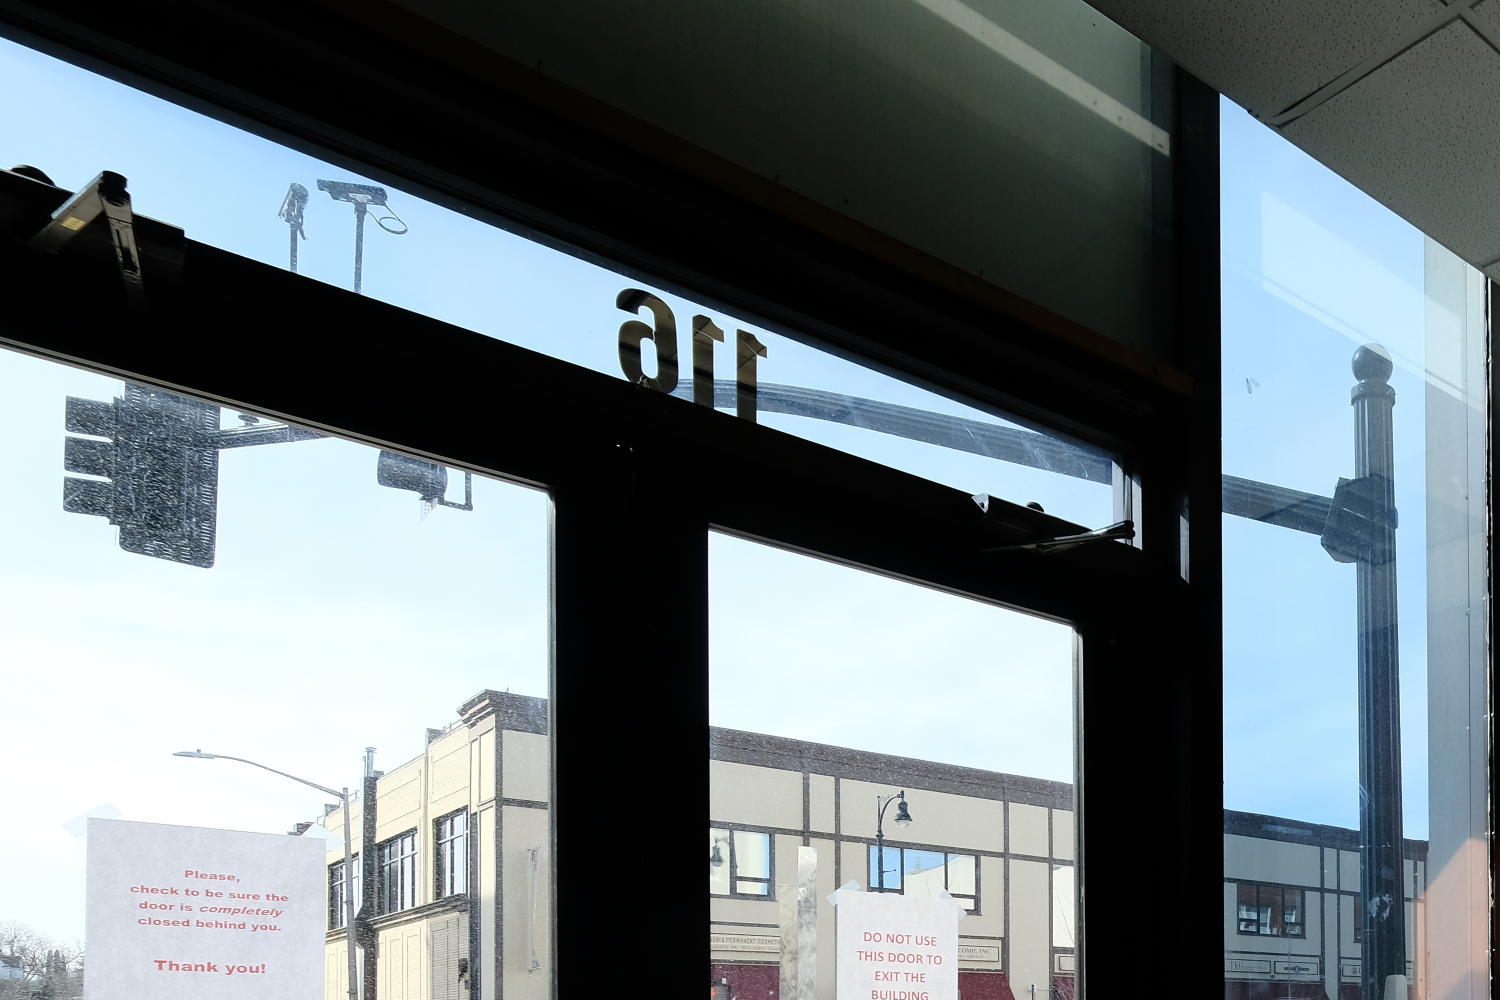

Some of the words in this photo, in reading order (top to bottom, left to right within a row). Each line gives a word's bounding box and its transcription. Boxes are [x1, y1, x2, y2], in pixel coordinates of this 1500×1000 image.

[184, 869, 240, 883] Please,
[130, 885, 180, 895] check
[184, 888, 200, 897] to
[205, 889, 223, 898] be
[228, 892, 260, 901] sure
[265, 893, 289, 902] the
[139, 901, 175, 911] door
[180, 903, 193, 912] is
[199, 905, 284, 918] completely
[137, 917, 190, 927] closed
[196, 919, 246, 930] behind
[251, 923, 282, 932] you.
[863, 931, 882, 943] DO
[886, 933, 912, 945] NOT
[915, 935, 937, 947] USE
[856, 950, 884, 962] THIS
[888, 952, 923, 964] DOOR
[926, 954, 943, 965] TO
[154, 959, 218, 973] Thank
[224, 963, 266, 976] you!
[874, 970, 900, 982] EXIT
[903, 972, 926, 983] THE
